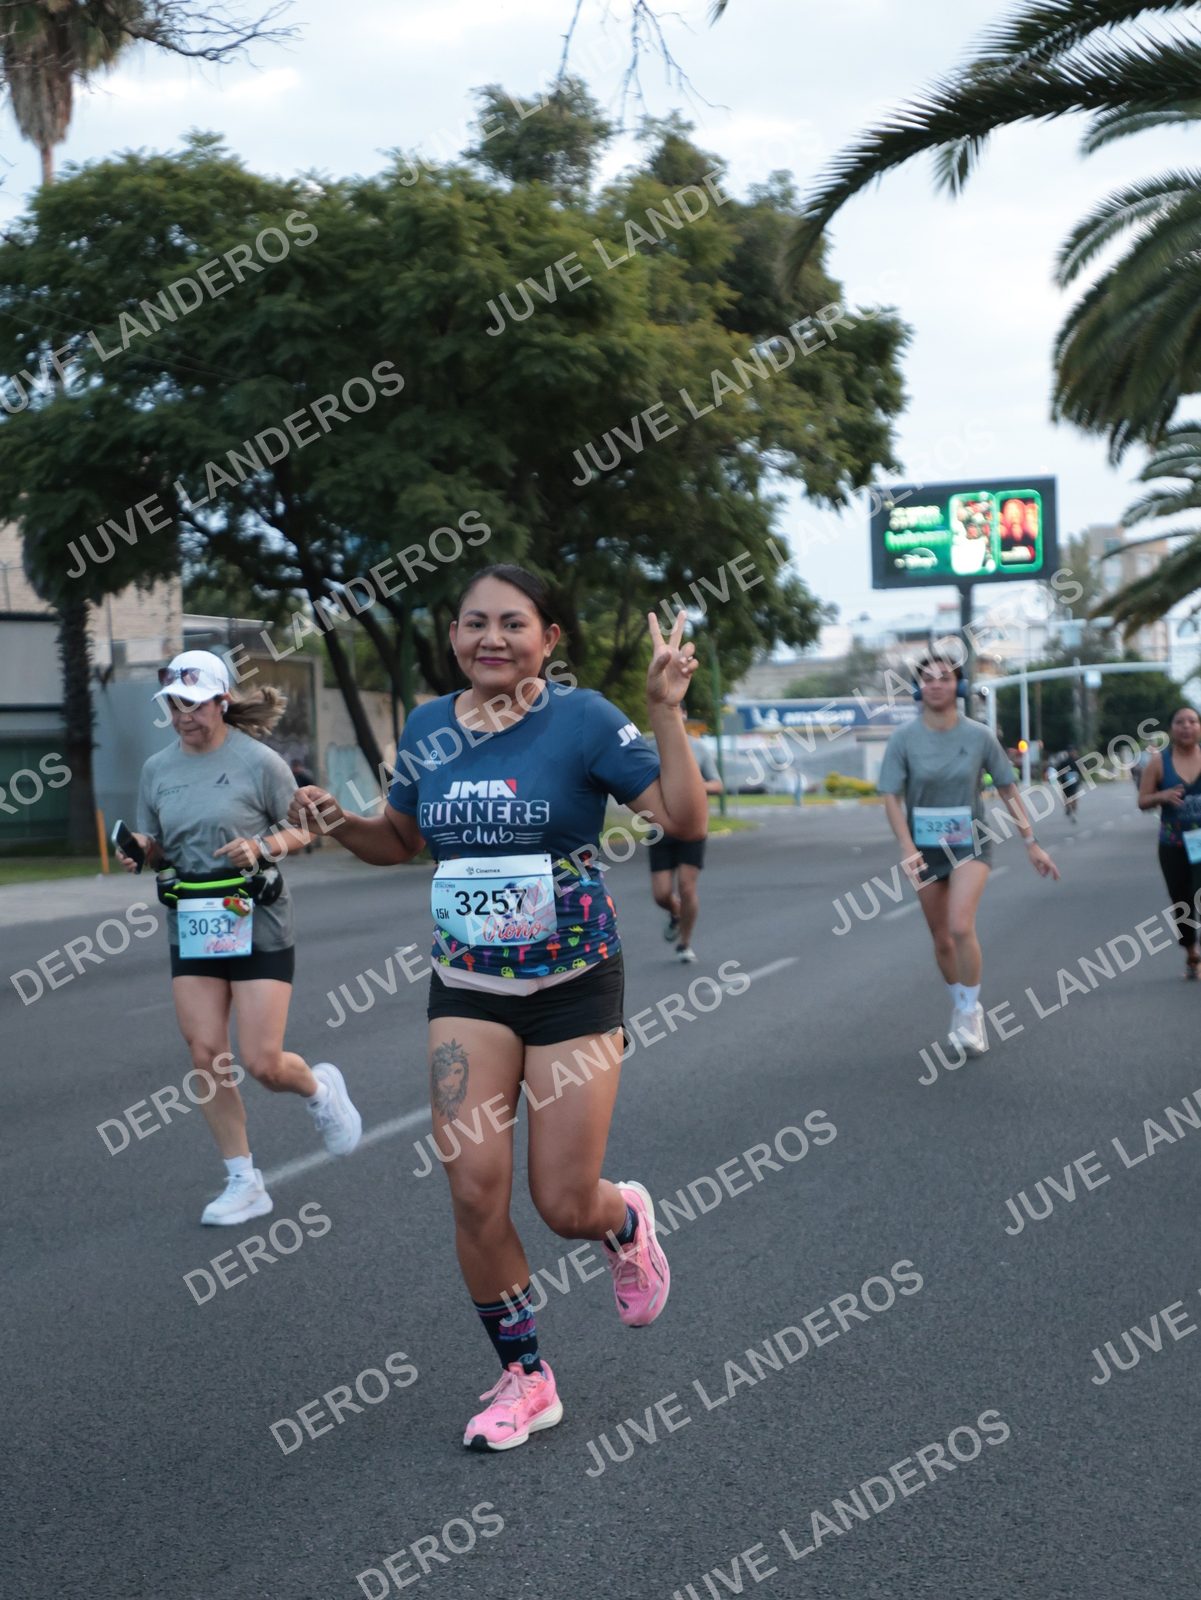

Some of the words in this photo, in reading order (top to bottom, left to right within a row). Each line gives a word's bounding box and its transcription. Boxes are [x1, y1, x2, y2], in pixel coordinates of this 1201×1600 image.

[443, 779, 517, 800] JMA
[420, 799, 550, 828] RUNNERS
[462, 825, 515, 845] club
[454, 888, 527, 917] 3257
[188, 918, 234, 936] 3031
